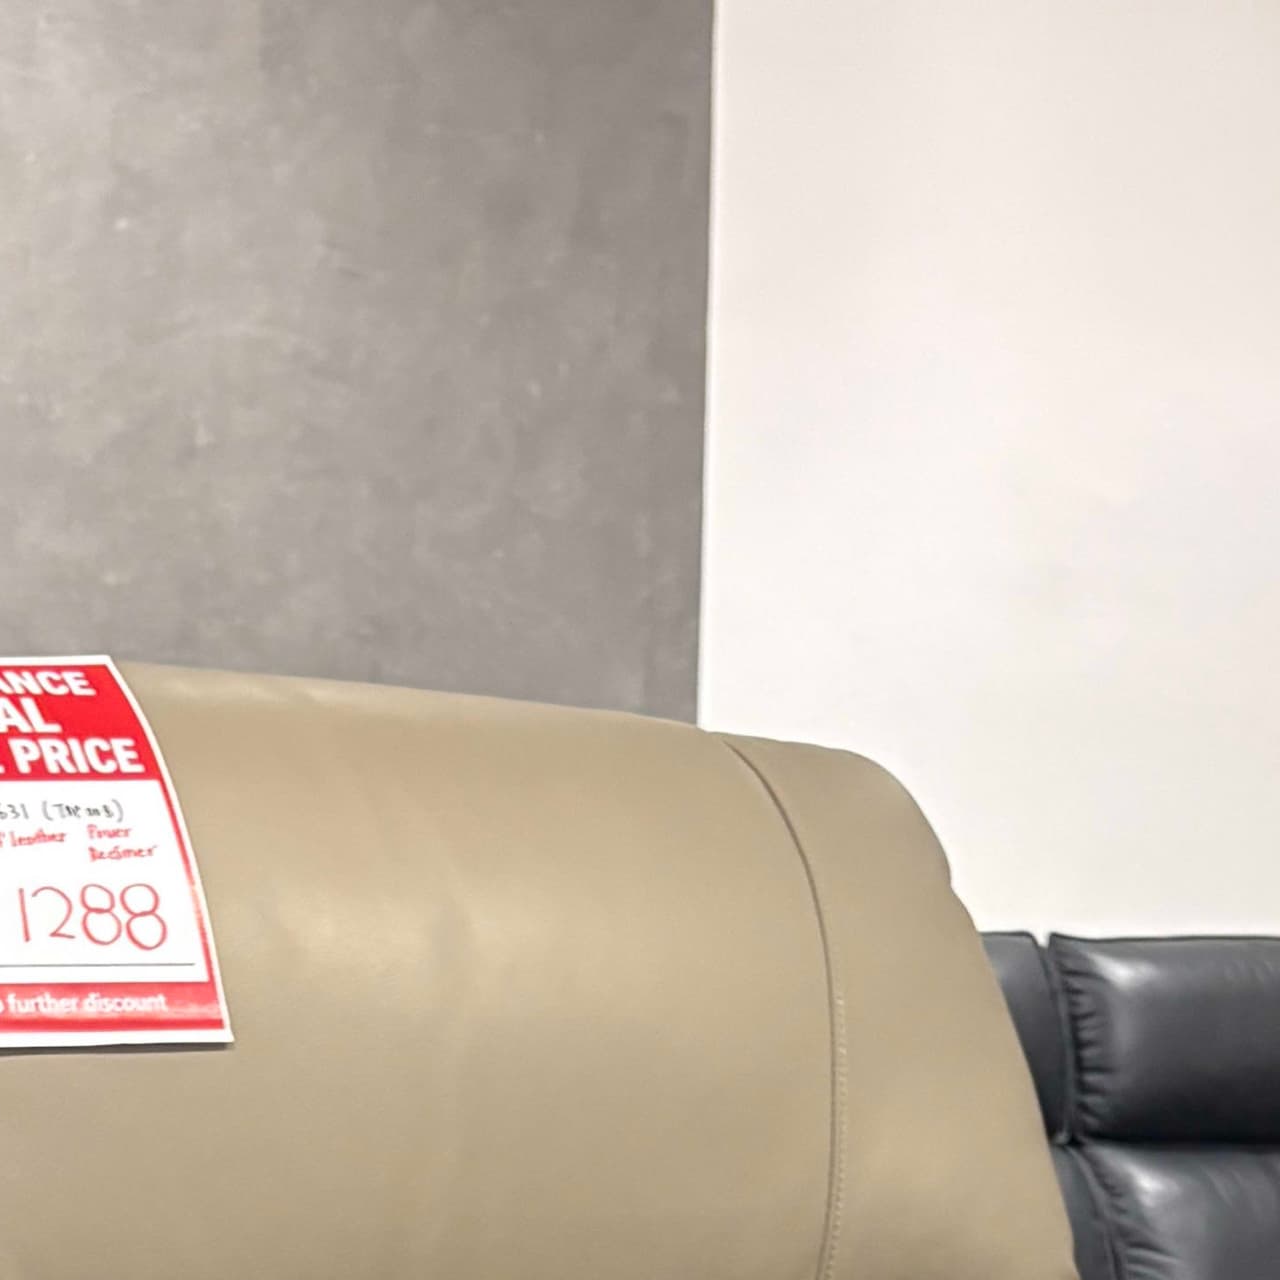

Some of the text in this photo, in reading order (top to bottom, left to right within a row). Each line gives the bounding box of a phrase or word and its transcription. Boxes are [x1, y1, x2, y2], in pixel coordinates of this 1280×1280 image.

[8, 738, 144, 774] PRICE
[18, 884, 168, 951] 1288
[7, 993, 79, 1013] further
[82, 992, 168, 1013] discount
